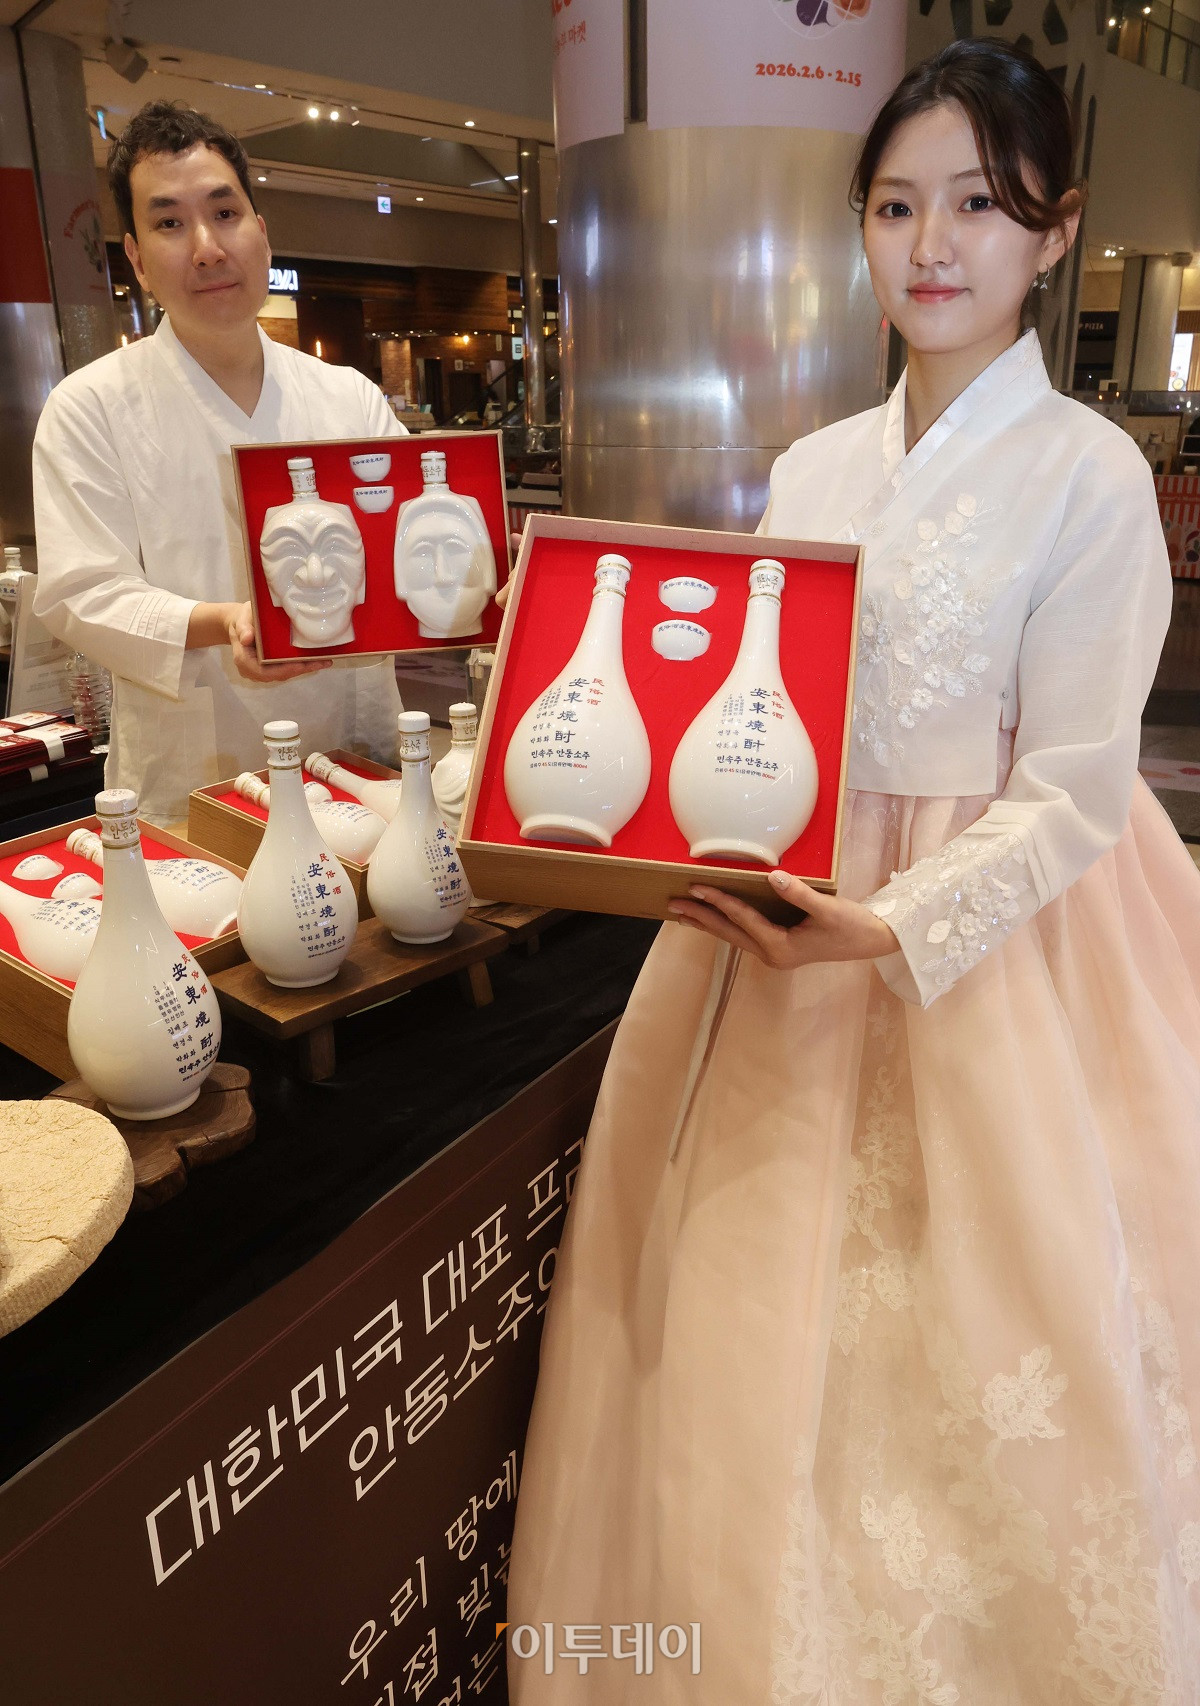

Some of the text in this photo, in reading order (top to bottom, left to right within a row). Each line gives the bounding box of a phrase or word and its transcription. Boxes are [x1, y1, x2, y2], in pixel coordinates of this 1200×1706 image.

[755, 63, 862, 87] 2026.2.6 2.15
[531, 748, 590, 760] 민속주 안동소주
[716, 755, 779, 772] 민속주 안동소주
[145, 1299, 404, 1587] 대한민국
[422, 1204, 512, 1335] 대표
[340, 1449, 518, 1686] 우리 땅에
